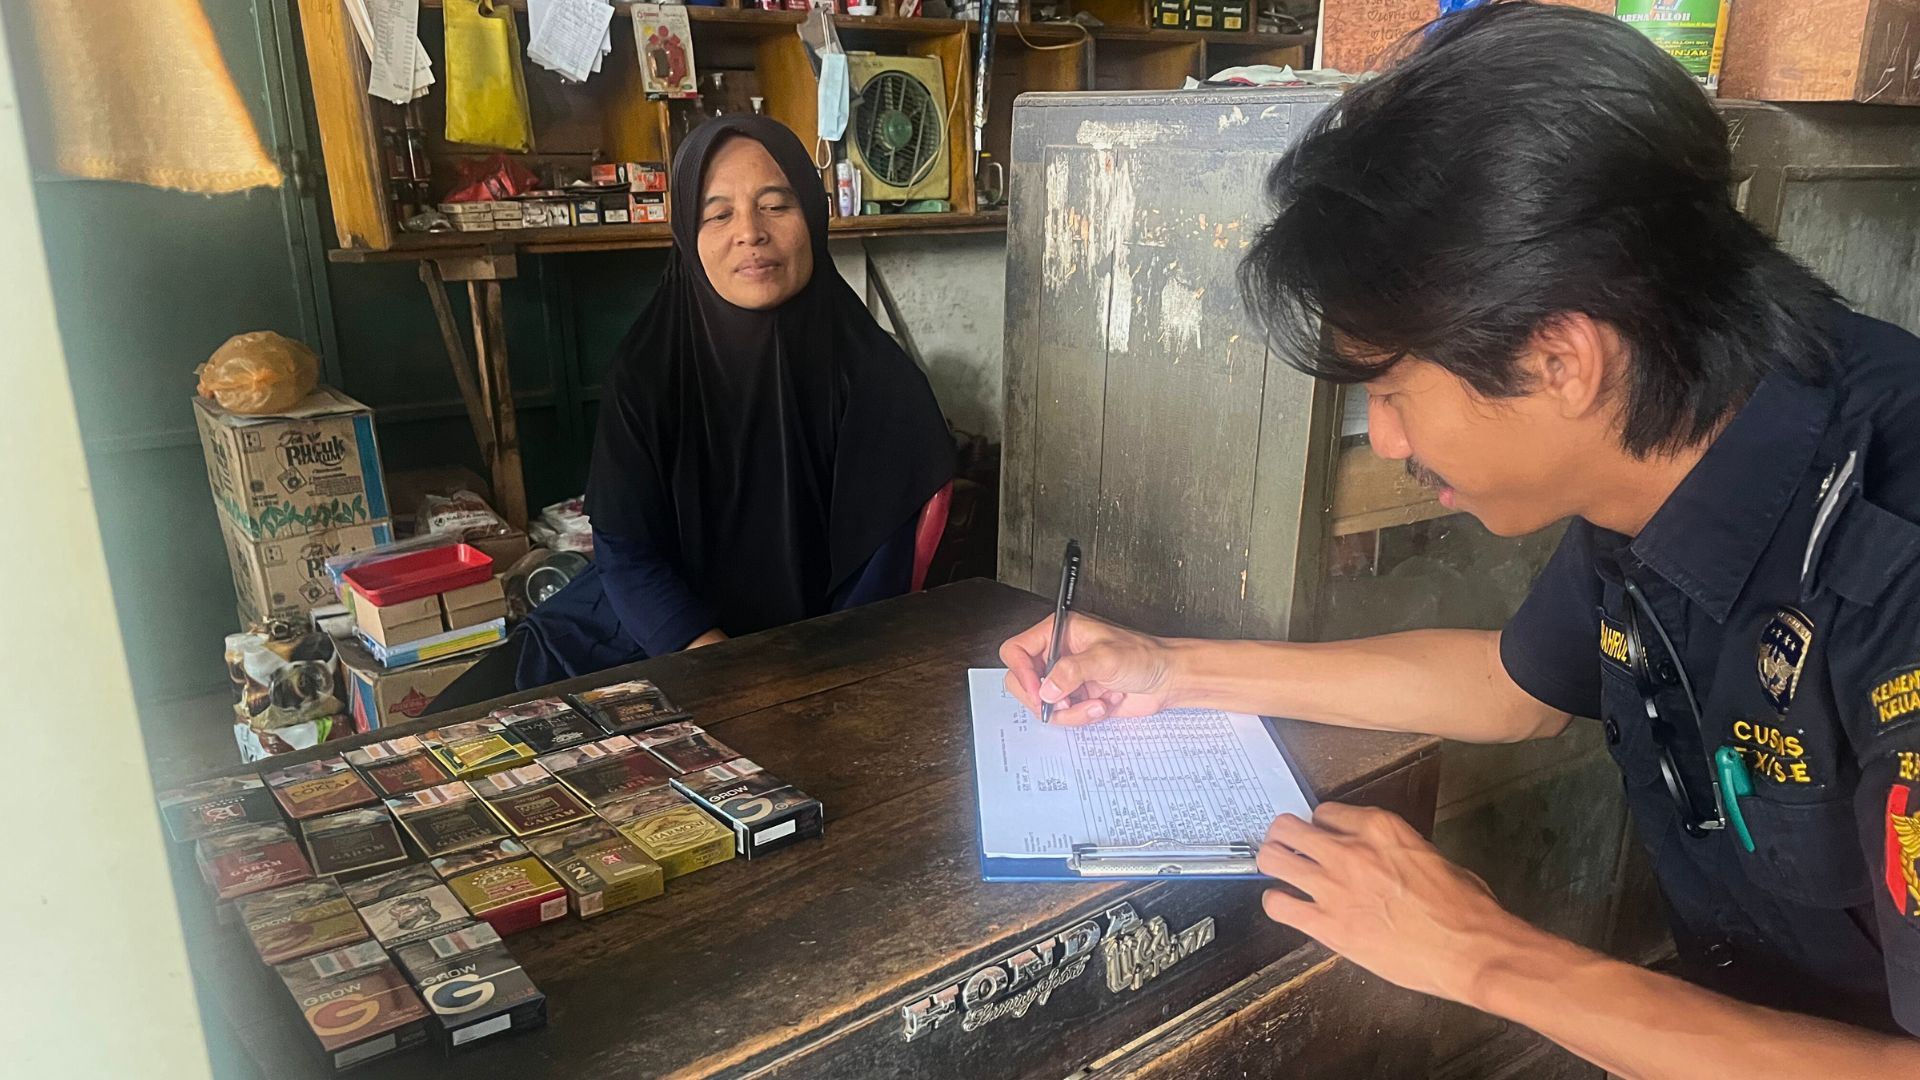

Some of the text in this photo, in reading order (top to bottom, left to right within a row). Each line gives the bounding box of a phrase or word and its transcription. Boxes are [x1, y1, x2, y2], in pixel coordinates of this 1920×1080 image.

[708, 785, 749, 803] GROW
[523, 808, 577, 827] GARAM
[229, 860, 282, 877] GARAM
[420, 963, 477, 987] GROW
[902, 901, 1144, 1043] HONDA
[303, 983, 361, 1007] GROW
